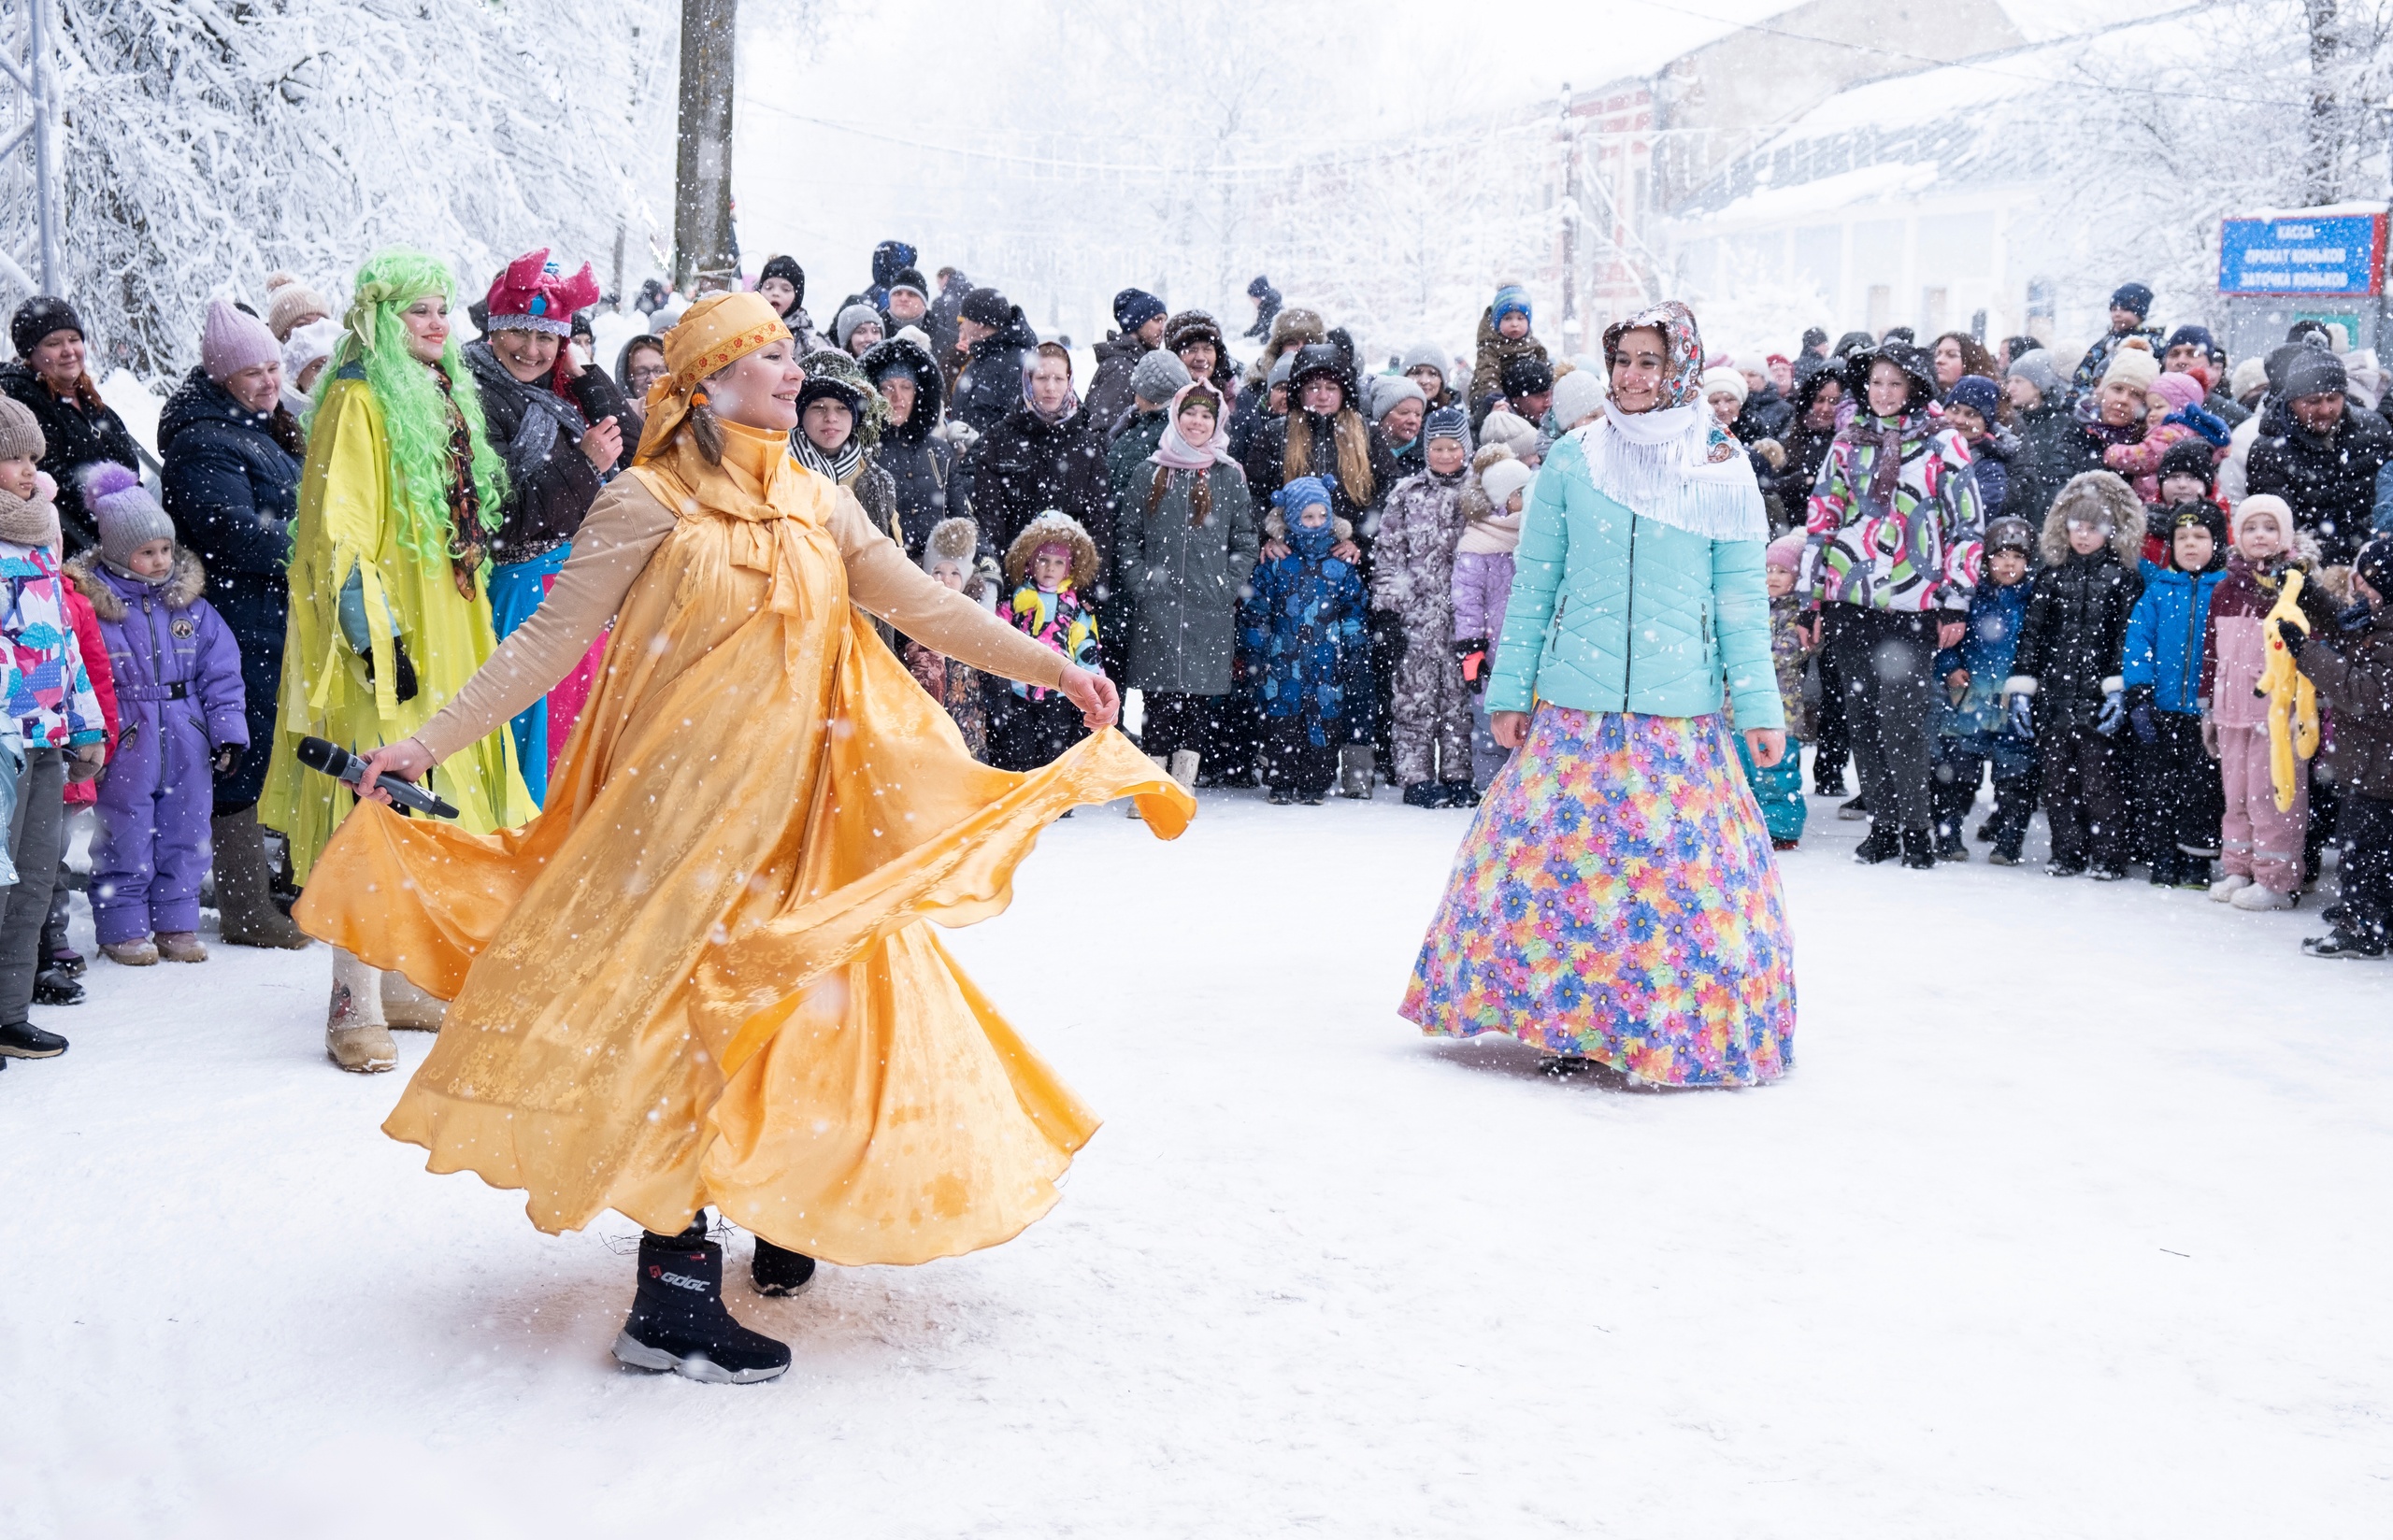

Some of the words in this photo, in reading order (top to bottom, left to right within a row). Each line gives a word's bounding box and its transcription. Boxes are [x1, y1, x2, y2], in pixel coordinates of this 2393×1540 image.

[2278, 225, 2314, 239] КАССА
[2245, 249, 2290, 263] ПРОКАТ
[2293, 249, 2345, 263] КОНЬКОВ
[2241, 273, 2290, 287] ЗАТОЧКА
[2294, 273, 2347, 287] КОНЬКОВ
[661, 1273, 710, 1291] GOGC
